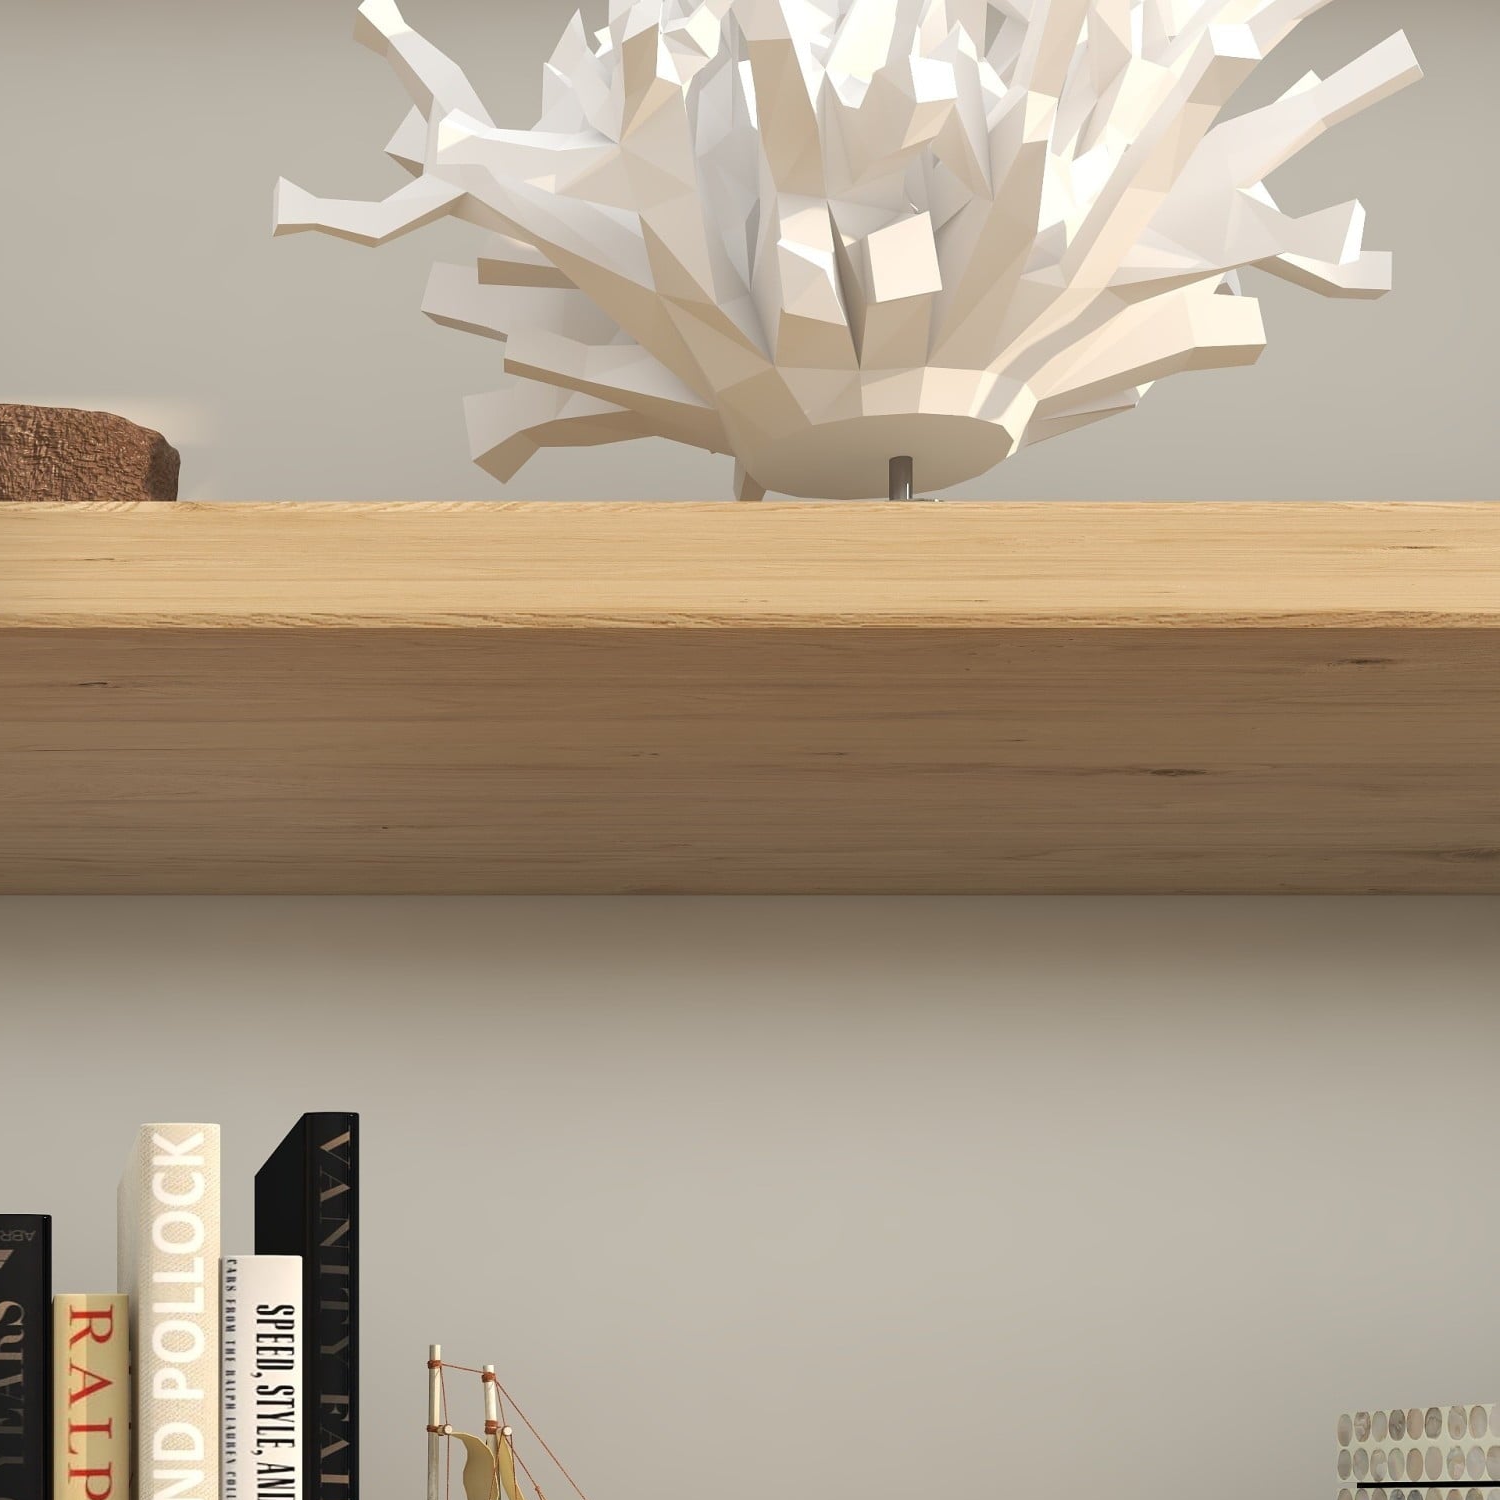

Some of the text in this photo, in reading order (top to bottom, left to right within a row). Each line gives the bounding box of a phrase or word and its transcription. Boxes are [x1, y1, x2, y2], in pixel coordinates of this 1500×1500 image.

[152, 1130, 206, 1401] POLLOCK
[319, 1130, 351, 1367] VANITY
[225, 1258, 238, 1293] CARS
[225, 1299, 238, 1333] FROM
[225, 1340, 238, 1363] THE
[251, 1304, 296, 1379] SPEED,
[225, 1369, 238, 1411] RALPH
[225, 1417, 238, 1465] LAUREN
[251, 1385, 296, 1456] STYLE,
